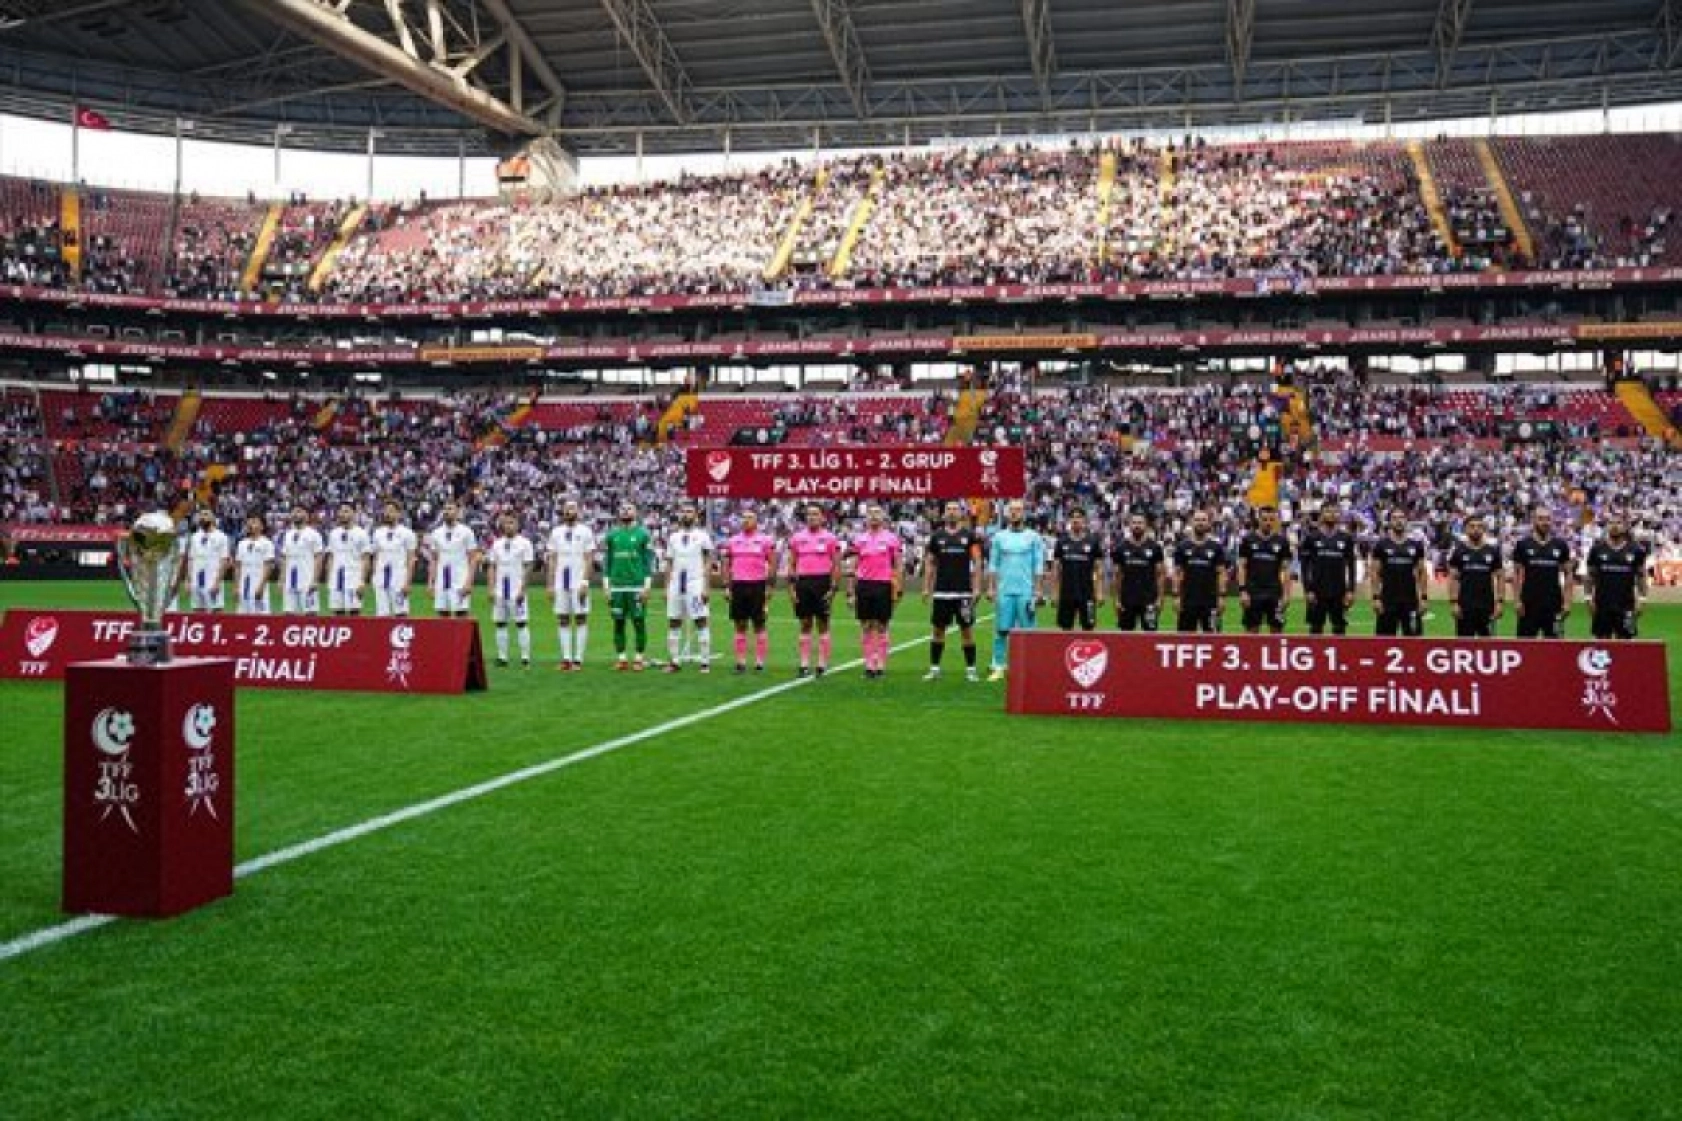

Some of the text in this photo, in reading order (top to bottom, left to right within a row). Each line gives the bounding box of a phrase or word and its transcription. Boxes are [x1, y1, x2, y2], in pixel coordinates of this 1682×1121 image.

[752, 453, 783, 469] TFF
[787, 453, 805, 469] 3.
[810, 450, 840, 469] LİG
[846, 453, 859, 469] 1.
[880, 453, 896, 469] 2.
[902, 453, 956, 469] GRUP
[773, 474, 931, 494] PLAY-OFF FİNALİ
[92, 619, 135, 642] TFF
[211, 623, 228, 645] 1.
[252, 624, 274, 646] 2.
[283, 626, 351, 648] GRUP
[19, 661, 50, 675] TFF
[234, 651, 318, 682] FİNALİ
[1155, 639, 1522, 675] TFF 3. LİG 1. - 2. GRUP
[1065, 692, 1105, 710] TFF
[1196, 681, 1480, 716] PLAY-OFF FİNALİ
